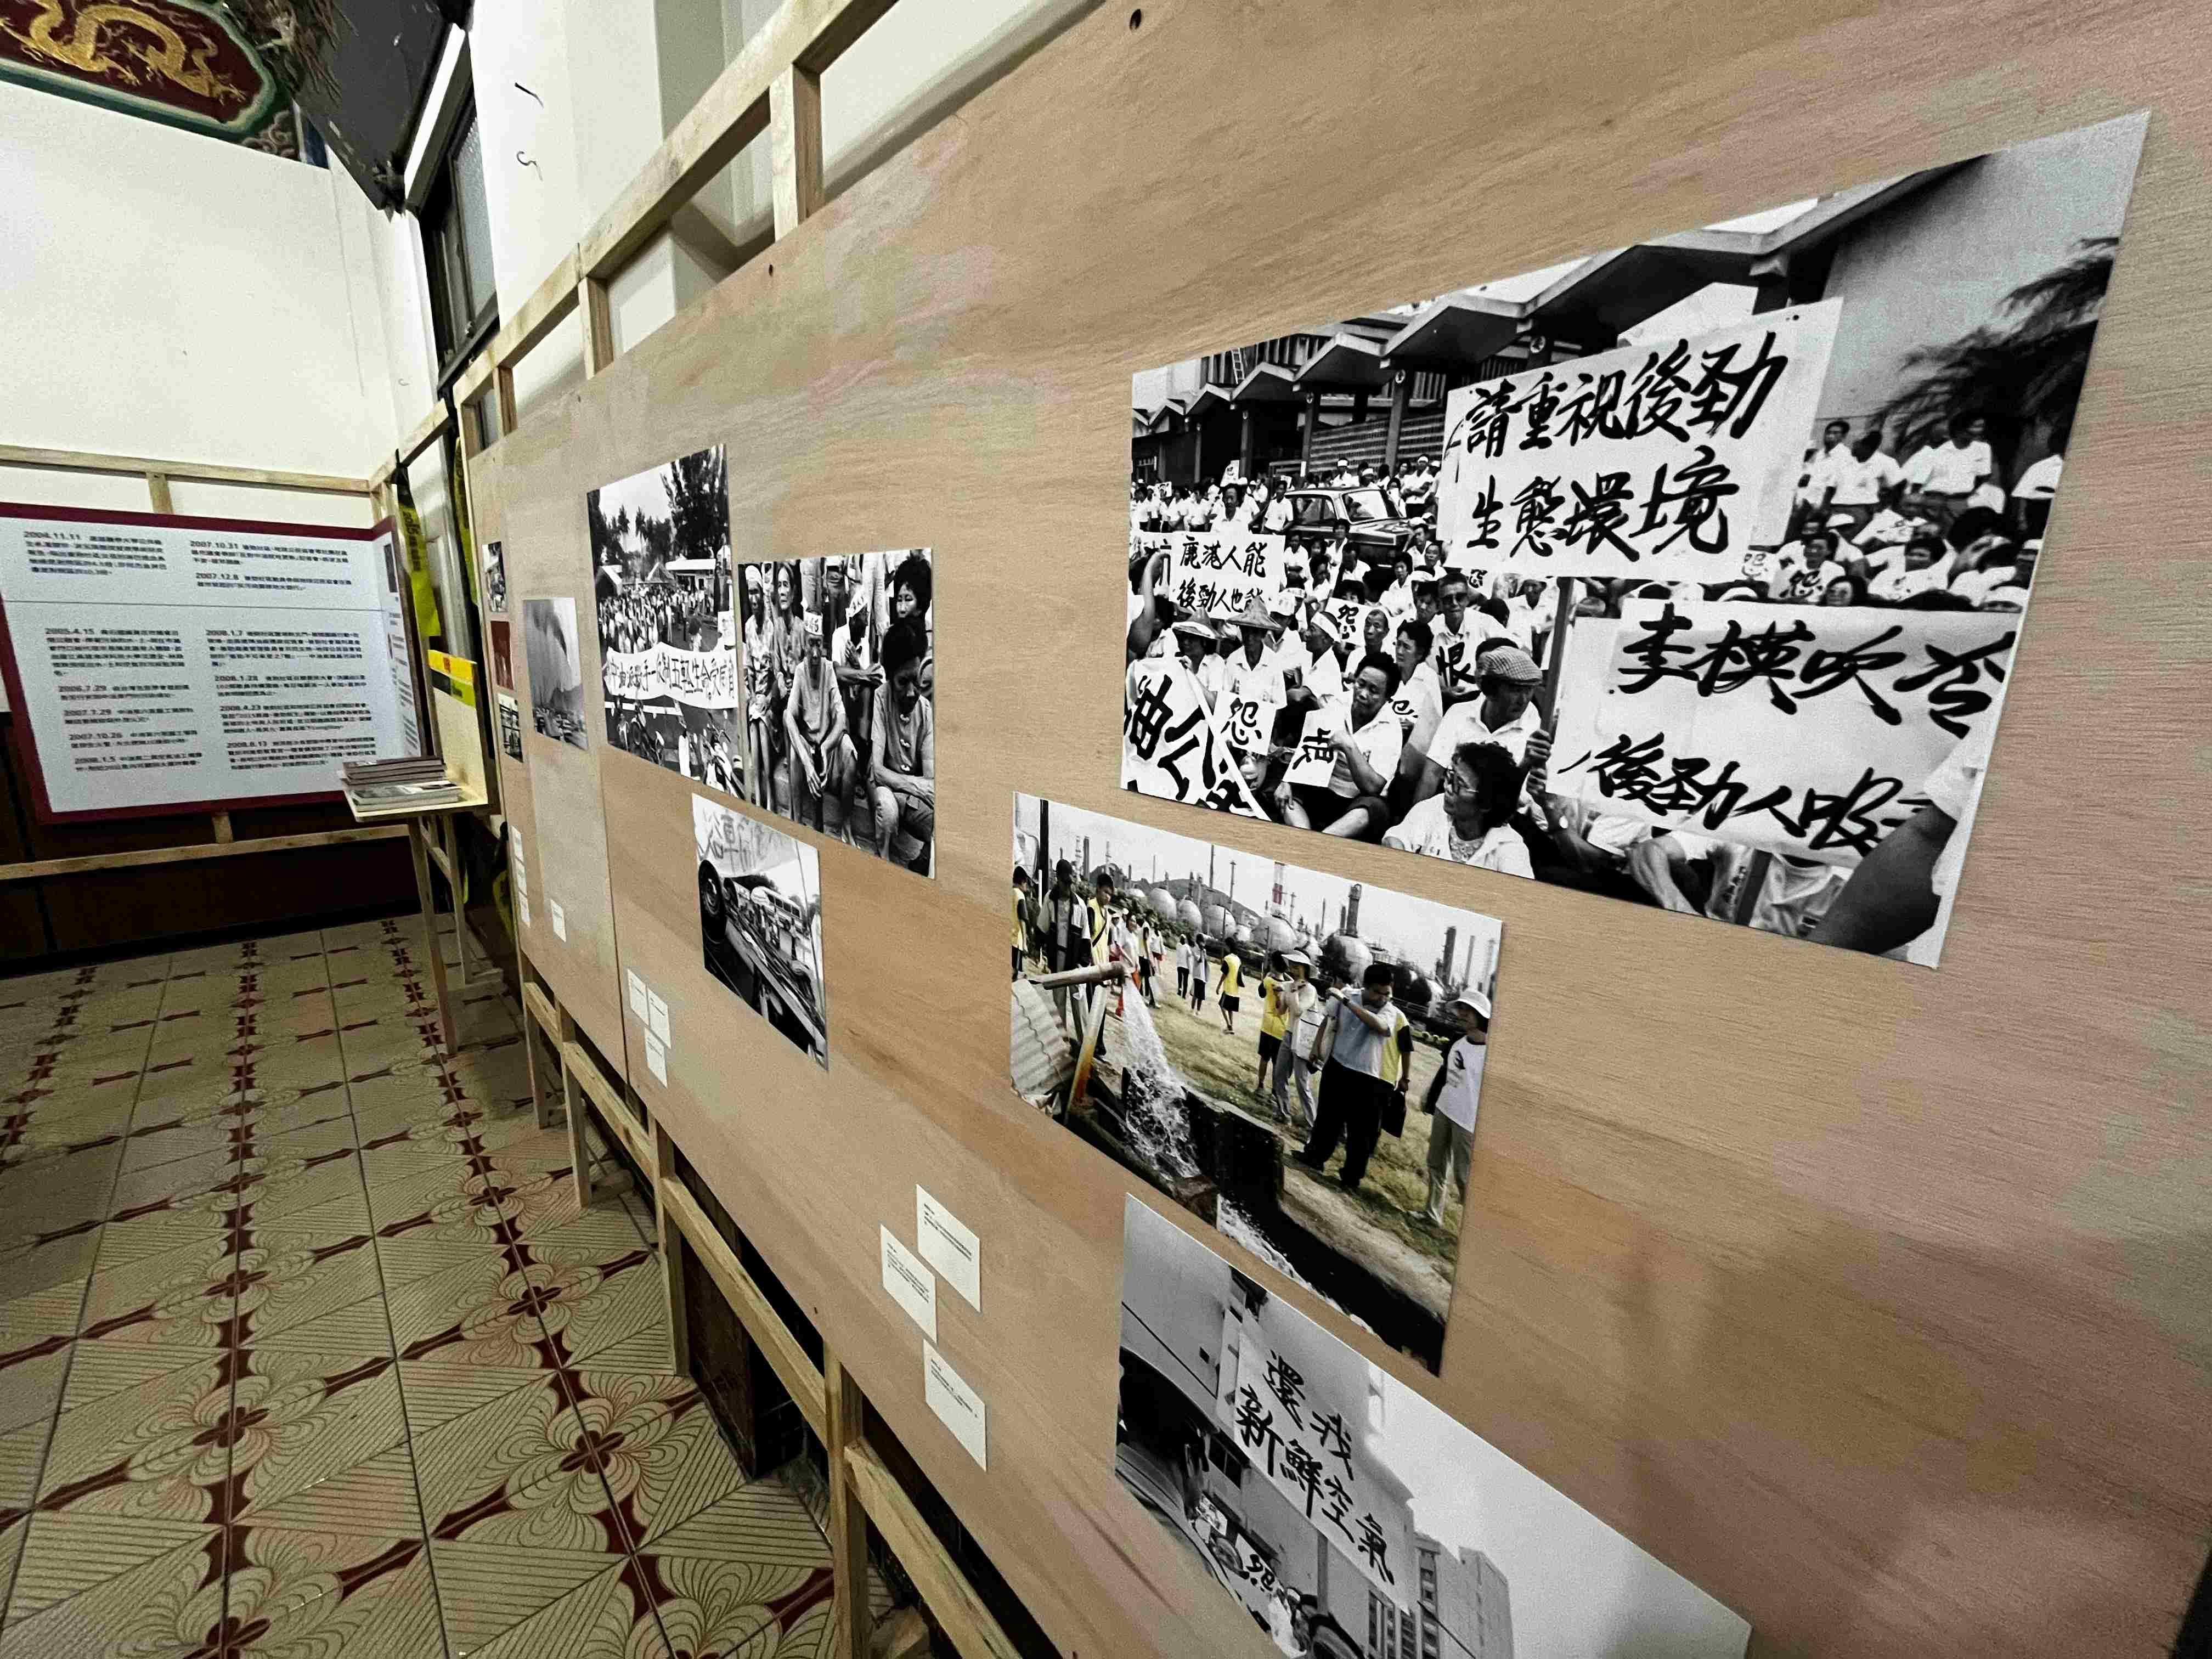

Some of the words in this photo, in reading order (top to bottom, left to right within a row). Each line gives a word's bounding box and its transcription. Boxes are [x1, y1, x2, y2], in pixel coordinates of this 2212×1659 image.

[1465, 331, 1788, 458] 請重視後勁
[1180, 535, 1268, 578] 鹿港人能
[1466, 445, 1739, 562] 生態環境
[1221, 697, 1262, 746] 怨
[1436, 641, 1477, 687] 恨
[1558, 731, 1932, 858] 後勁人吸
[1262, 1349, 1354, 1481] 還我
[1235, 1383, 1395, 1585] 新鮮空氣
